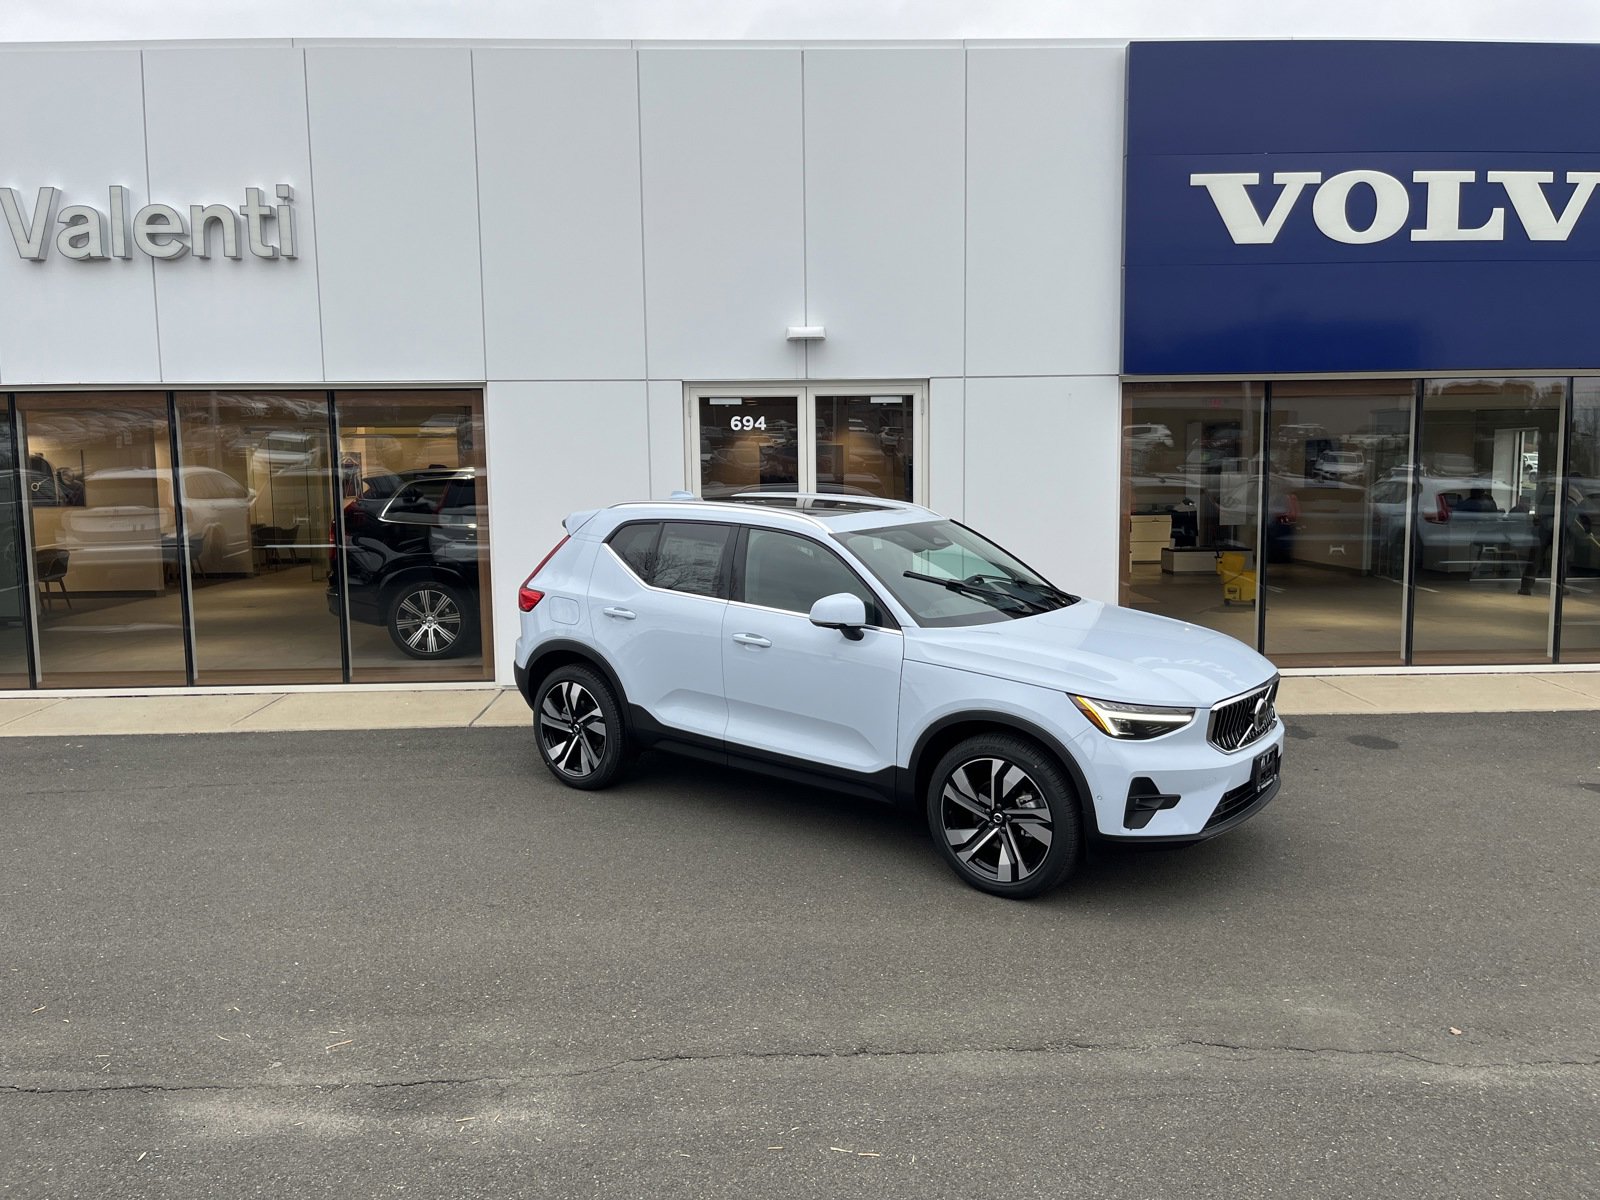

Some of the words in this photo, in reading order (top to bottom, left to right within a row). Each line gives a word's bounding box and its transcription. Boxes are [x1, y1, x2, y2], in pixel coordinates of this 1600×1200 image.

[0, 184, 298, 261] Valenti
[1190, 169, 1600, 244] VOLV
[730, 415, 766, 431] 694
